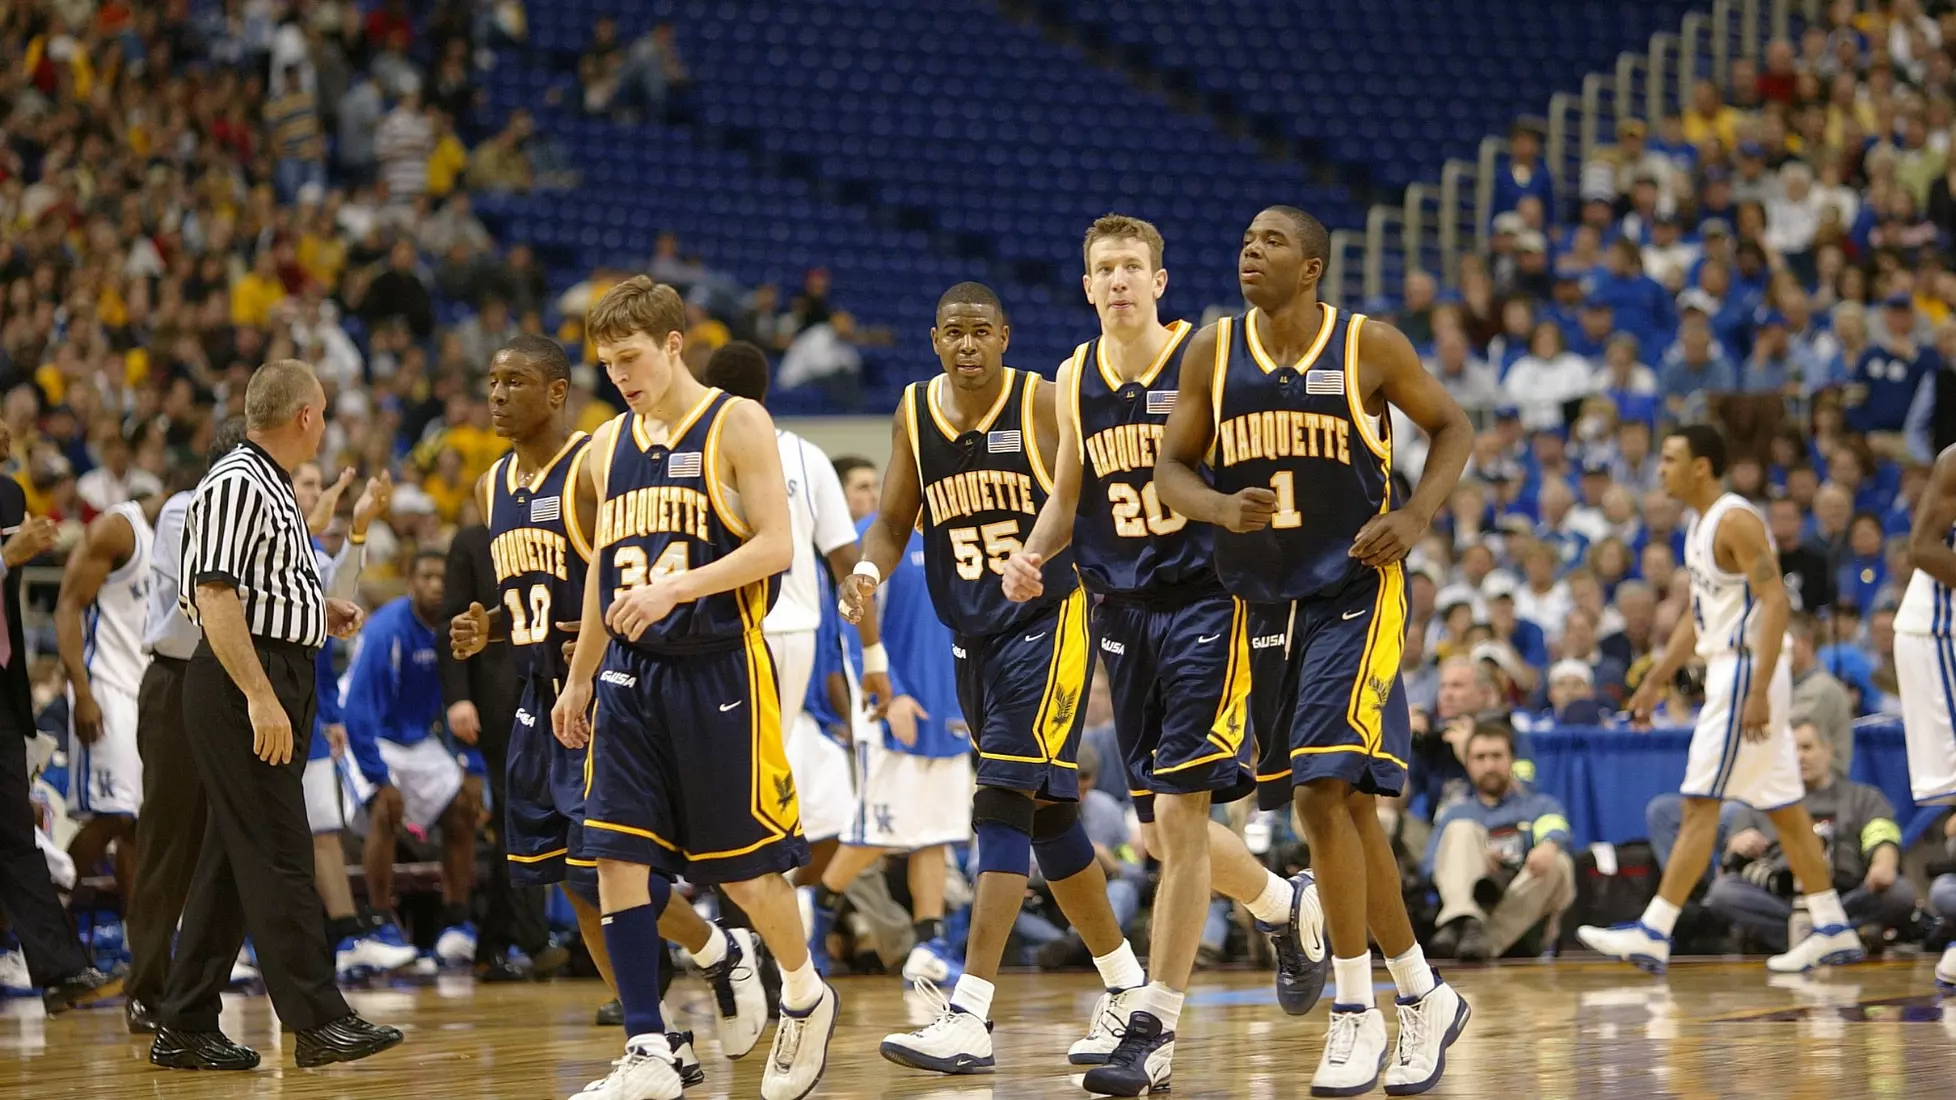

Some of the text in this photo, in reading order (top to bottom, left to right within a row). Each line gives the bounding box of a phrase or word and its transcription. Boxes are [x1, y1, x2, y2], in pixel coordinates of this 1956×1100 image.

[1086, 424, 1166, 479] MARQUET
[1220, 410, 1351, 467] MARQUETTE
[600, 486, 709, 550] MARQUETTE
[925, 469, 1036, 527] MARQUETTE
[1107, 480, 1188, 537] 20
[1269, 470, 1302, 529] 1
[613, 541, 690, 602] 34
[948, 519, 1024, 581] 55
[504, 584, 551, 645] 10
